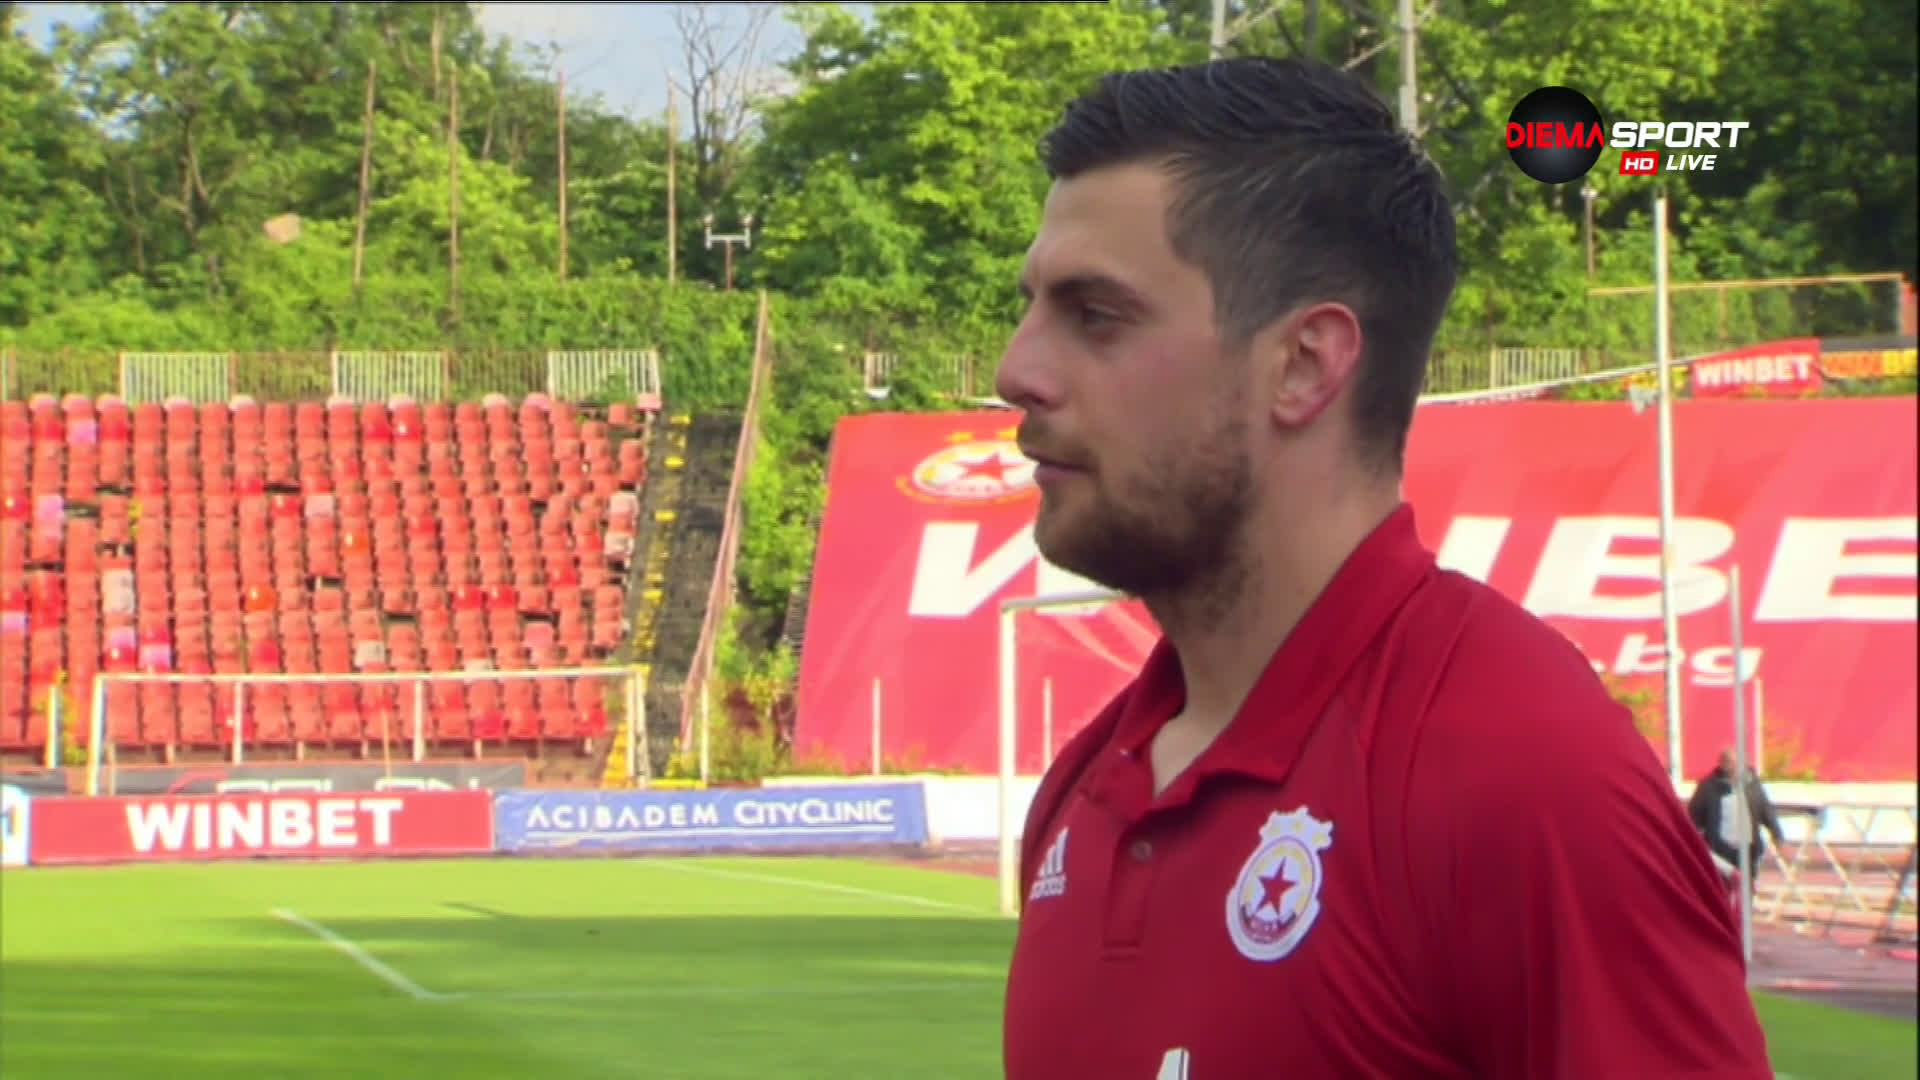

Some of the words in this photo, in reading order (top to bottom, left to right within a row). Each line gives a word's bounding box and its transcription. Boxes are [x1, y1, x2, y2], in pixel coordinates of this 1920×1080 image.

[1695, 353, 1812, 386] WINBET
[125, 798, 403, 851] WINBET
[526, 802, 719, 829] ACIBADEM
